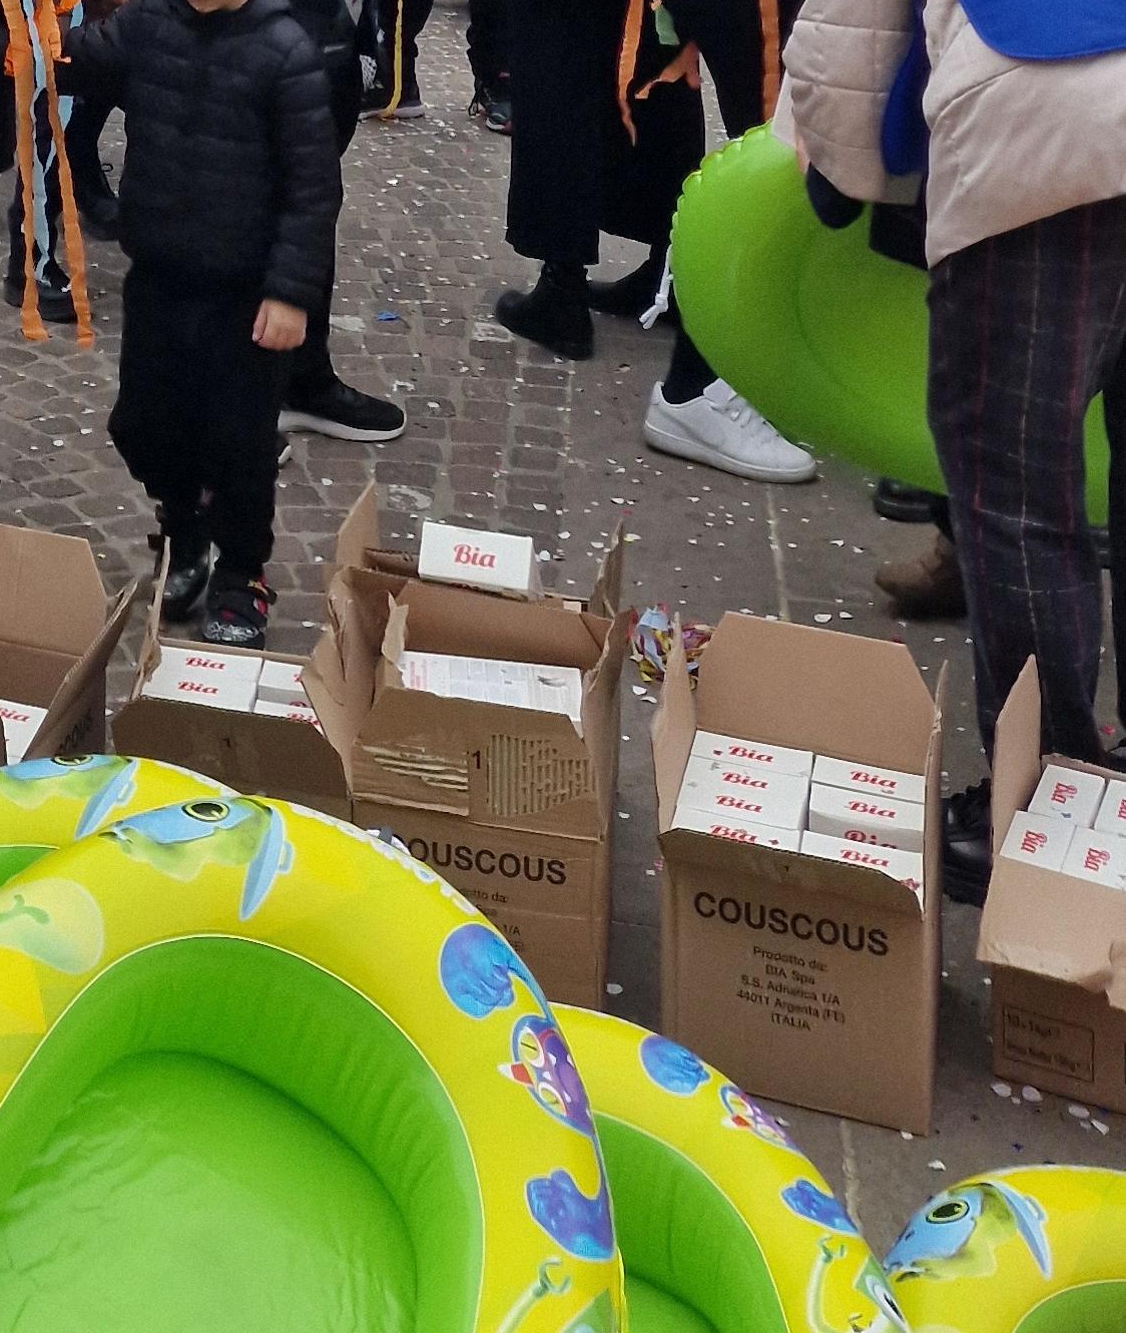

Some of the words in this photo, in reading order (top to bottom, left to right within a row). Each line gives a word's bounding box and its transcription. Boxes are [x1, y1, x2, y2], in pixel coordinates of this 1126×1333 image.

[454, 544, 497, 568] Bia
[186, 657, 226, 670] Bia
[178, 681, 219, 695] Bia
[729, 745, 774, 763] Bia
[722, 771, 769, 789] Bia
[850, 770, 898, 789] Bia
[1051, 782, 1078, 804] Bia
[715, 795, 763, 813] Bia
[848, 800, 896, 819] Bia
[1021, 829, 1048, 854] Bia
[399, 835, 567, 885] OUSCOUS
[840, 849, 890, 868] Bia
[1084, 847, 1111, 872] Bia
[693, 891, 889, 956] COUSCOUS
[753, 945, 806, 967] Prodotto
[765, 963, 787, 979] BIA
[736, 989, 770, 1006] 44011
[774, 997, 820, 1019] Argenta
[770, 1012, 812, 1032] ITALIA
